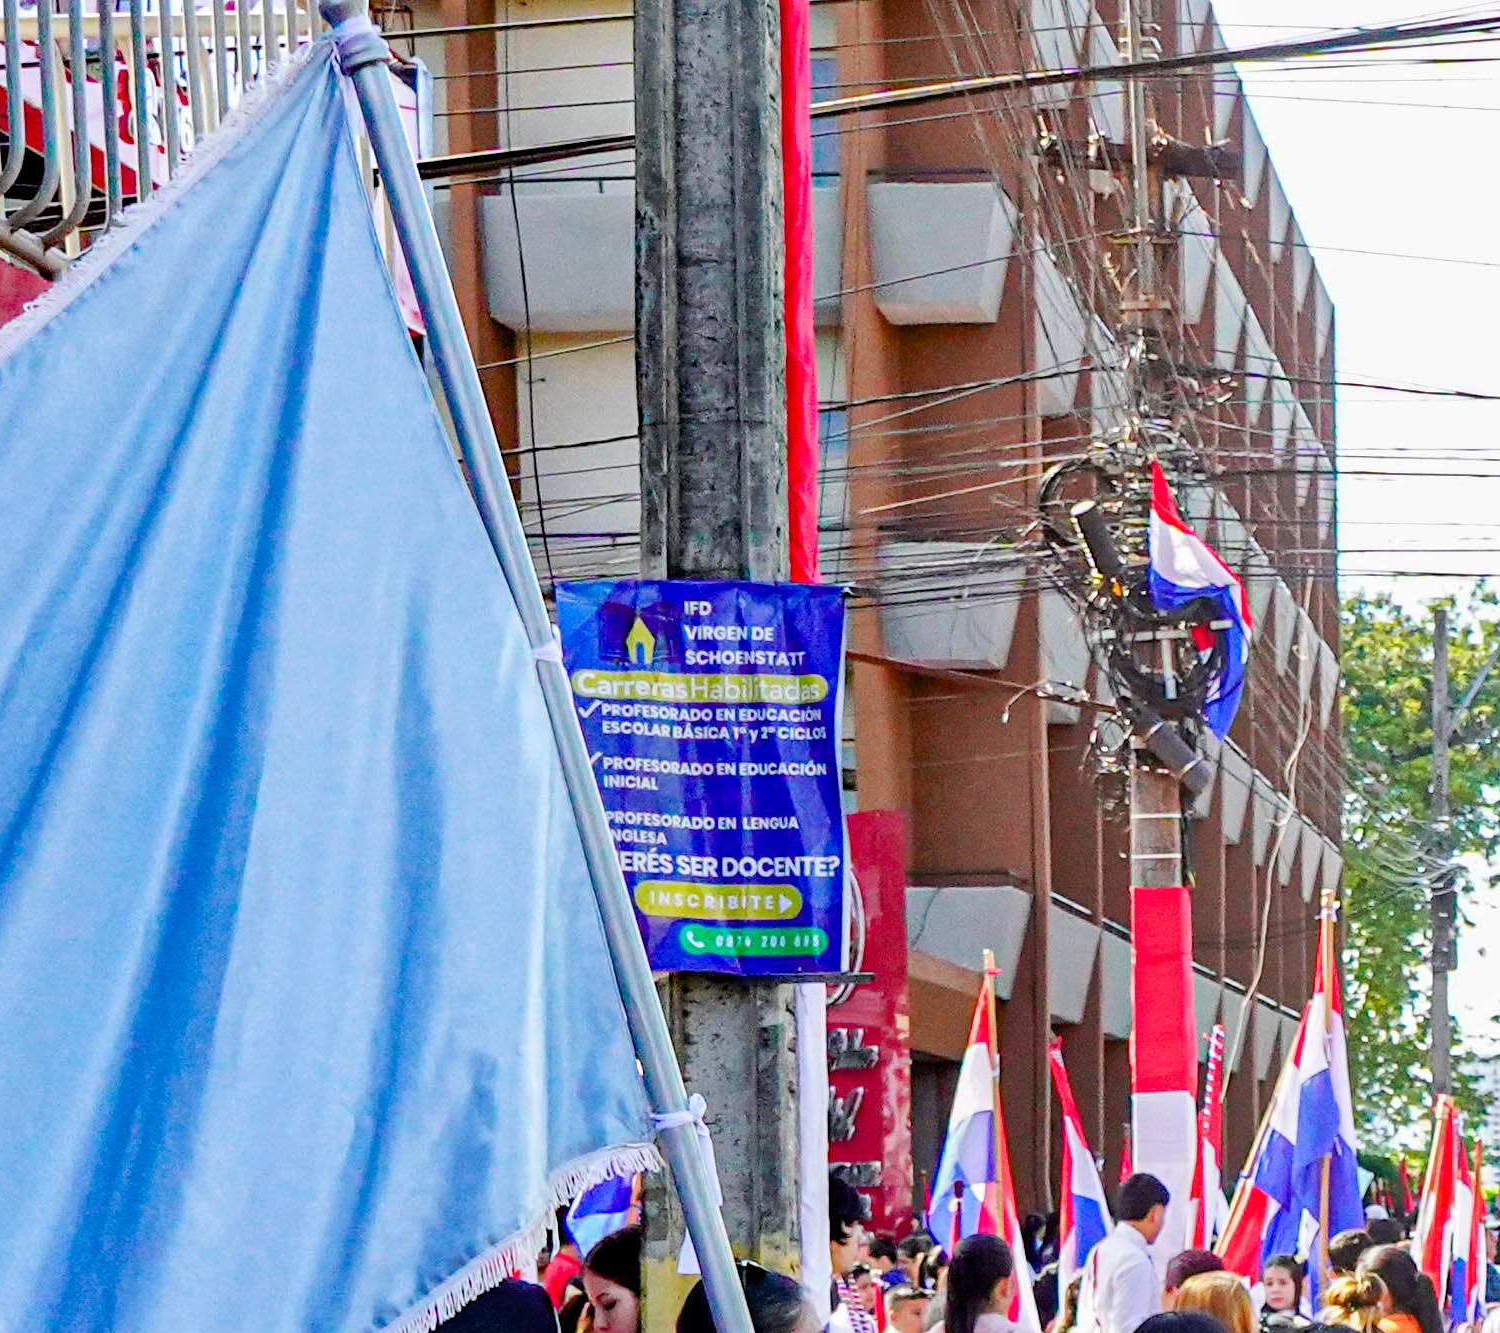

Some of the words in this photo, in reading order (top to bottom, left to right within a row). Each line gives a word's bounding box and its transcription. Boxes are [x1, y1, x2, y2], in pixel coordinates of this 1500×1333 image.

[684, 602, 711, 615] IFD
[684, 626, 747, 641] VIRGEN
[751, 626, 774, 641] DE
[685, 651, 805, 666] SCHOENSTATT
[577, 673, 687, 699] Carreras
[691, 677, 820, 701] Habilitadas
[602, 704, 710, 721] PROFESORADO
[716, 708, 736, 721] EN
[739, 706, 821, 722] EDUCACIÓN
[602, 722, 669, 737] ESCOLAR
[673, 721, 730, 739] BÁSICA
[748, 730, 758, 743] y
[778, 727, 826, 741] CICLOS
[603, 757, 714, 776] PROFESORADO
[717, 762, 736, 775] EN
[739, 760, 827, 776] EDUCACIÓN
[603, 776, 658, 790] INICIAL
[606, 811, 714, 829] PROFESORADO
[718, 817, 736, 829] EN
[742, 816, 799, 829] LENGUA
[611, 829, 668, 845] NGLESA
[619, 847, 674, 875] ERÉS
[677, 857, 718, 876] SER
[722, 856, 840, 877] DOCENTE?
